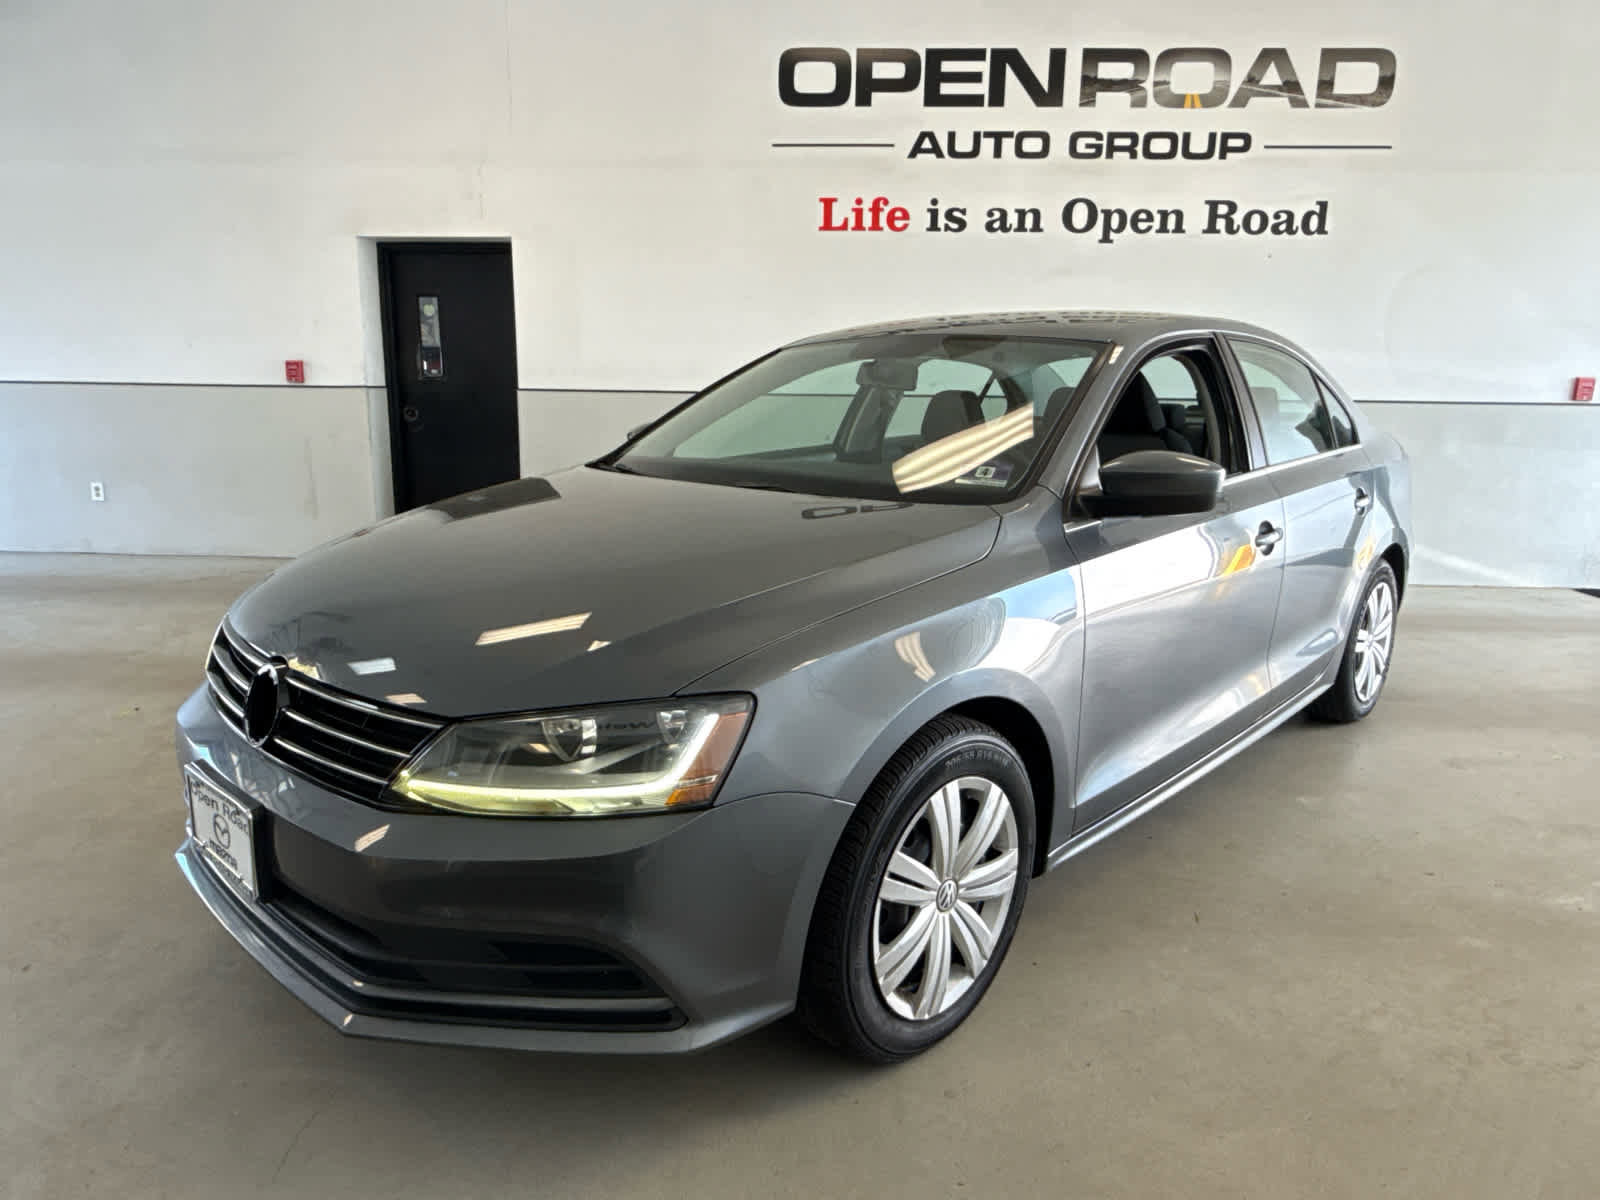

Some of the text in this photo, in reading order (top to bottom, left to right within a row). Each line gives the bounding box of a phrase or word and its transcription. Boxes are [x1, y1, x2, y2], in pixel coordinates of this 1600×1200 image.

[779, 47, 1397, 109] OPEN ROAD
[908, 131, 1252, 161] AUTO GROUP
[818, 197, 1329, 244] Life is an Open Road
